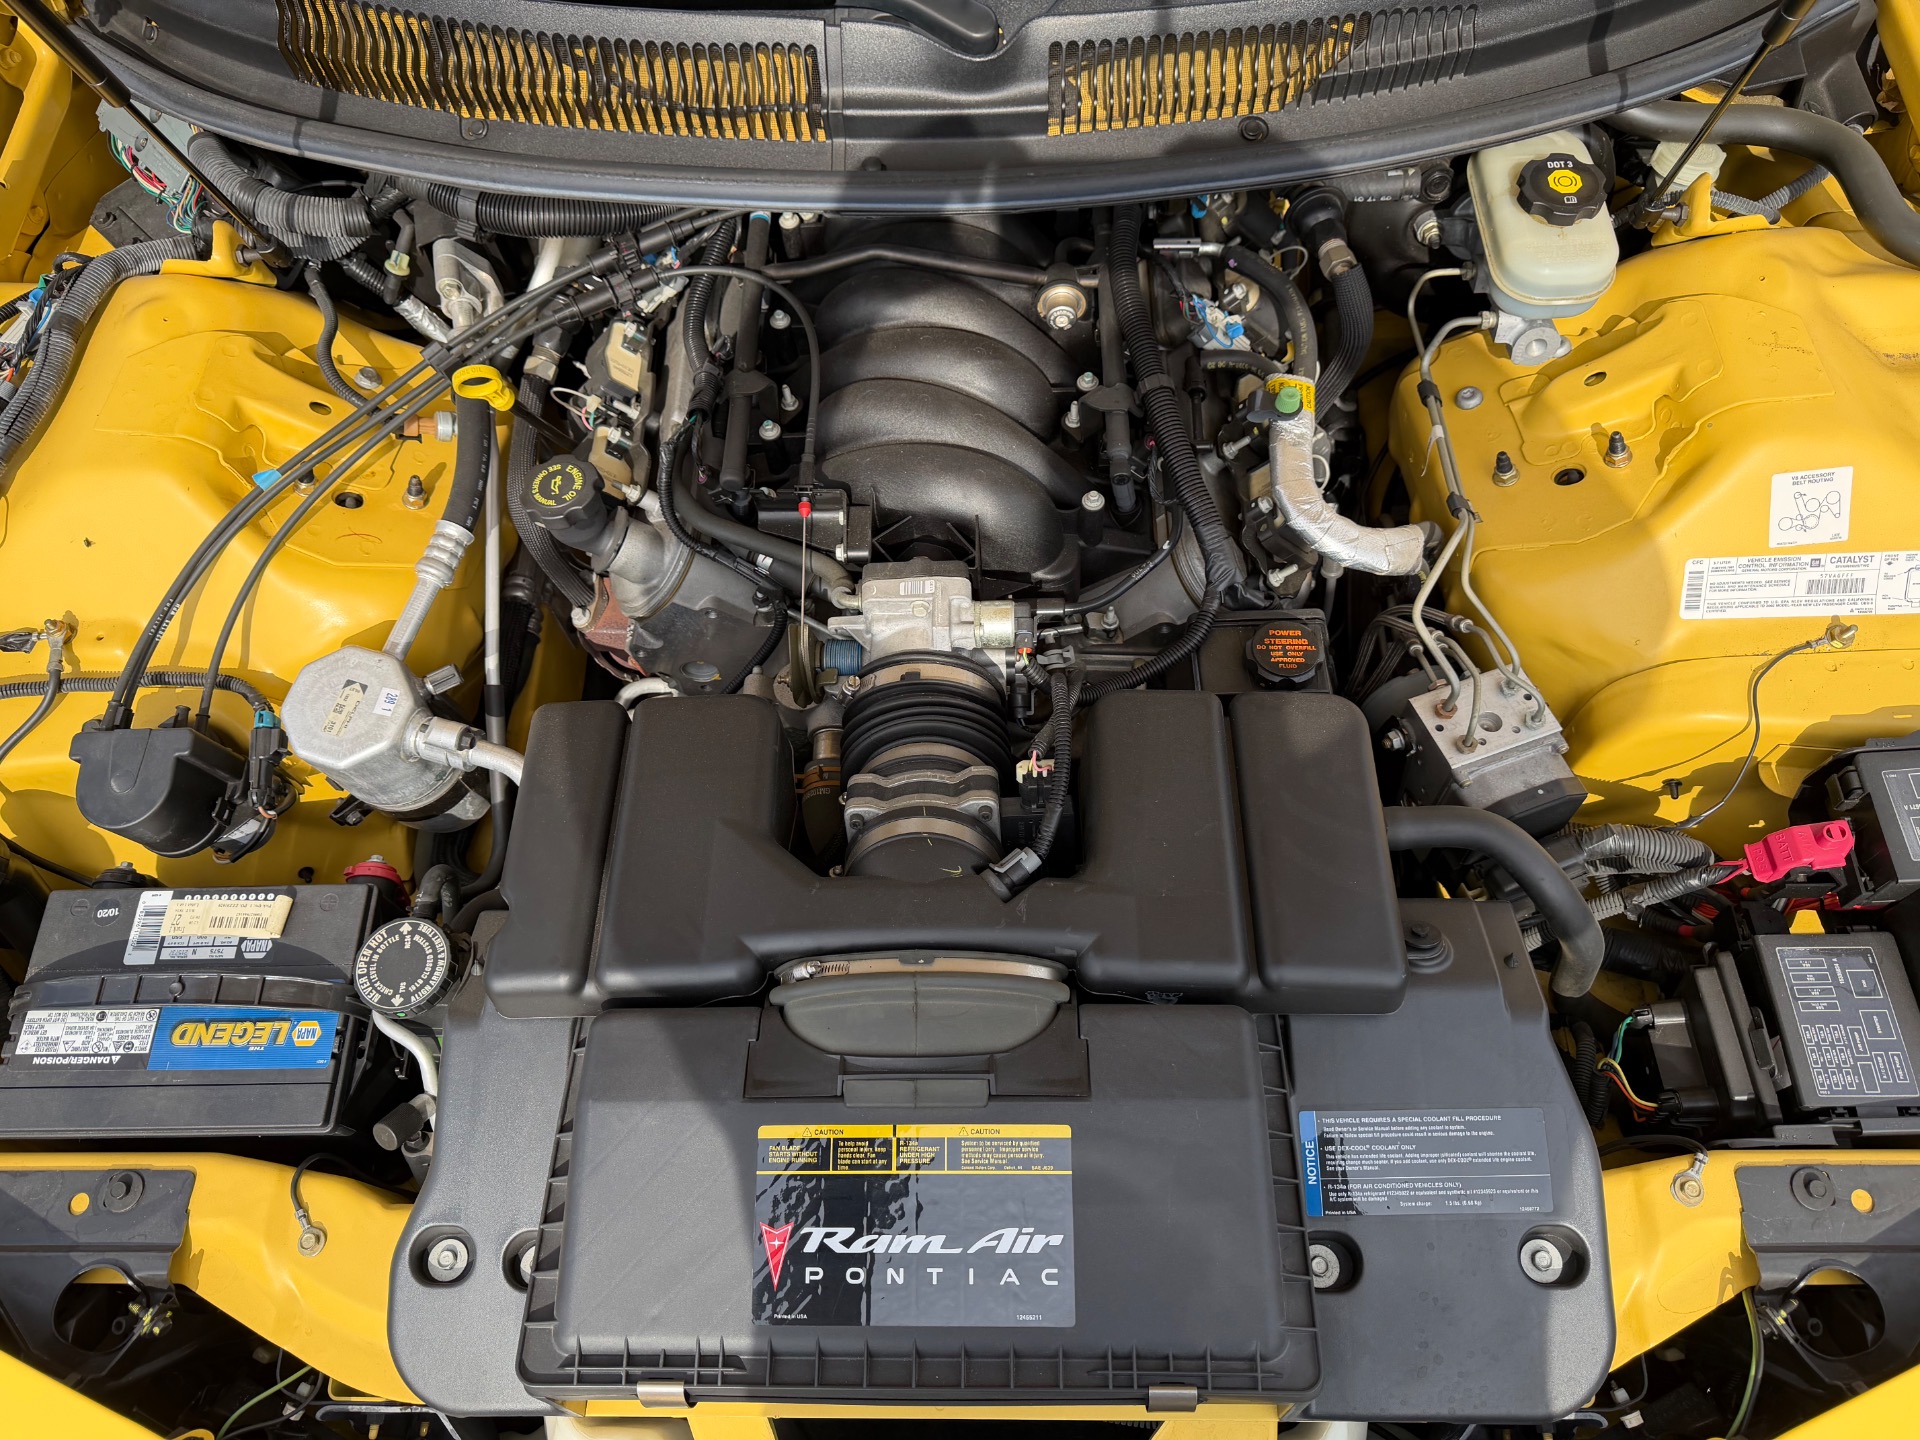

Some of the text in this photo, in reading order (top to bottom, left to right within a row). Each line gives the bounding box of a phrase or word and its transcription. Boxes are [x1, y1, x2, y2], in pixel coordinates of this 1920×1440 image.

[548, 464, 561, 472] SEE
[562, 465, 583, 501] ENGINE OIL
[534, 493, 556, 505] MANUAL
[1830, 555, 1874, 564] CATALYST
[1776, 833, 1794, 861] BATT
[171, 914, 182, 925] 27
[418, 924, 435, 937] TUBE
[246, 940, 269, 951] NAPA
[413, 934, 432, 954] SYSTEM
[432, 937, 445, 952] VENT
[358, 930, 388, 1003] NEVER OPEN HOT
[370, 934, 400, 995] CHECK LEVEL IN BOTTLE
[421, 955, 433, 979] CLOSED
[429, 960, 445, 985] ARROW
[411, 985, 431, 1003] ALIGN
[171, 1019, 292, 1046] LEGEND
[296, 1028, 317, 1039] NAPA
[32, 1056, 110, 1064] DANGER/POISON
[1305, 1140, 1317, 1185] NOTICE
[800, 1227, 1064, 1254] Ram Air
[805, 1267, 1059, 1286] PONTIAC
